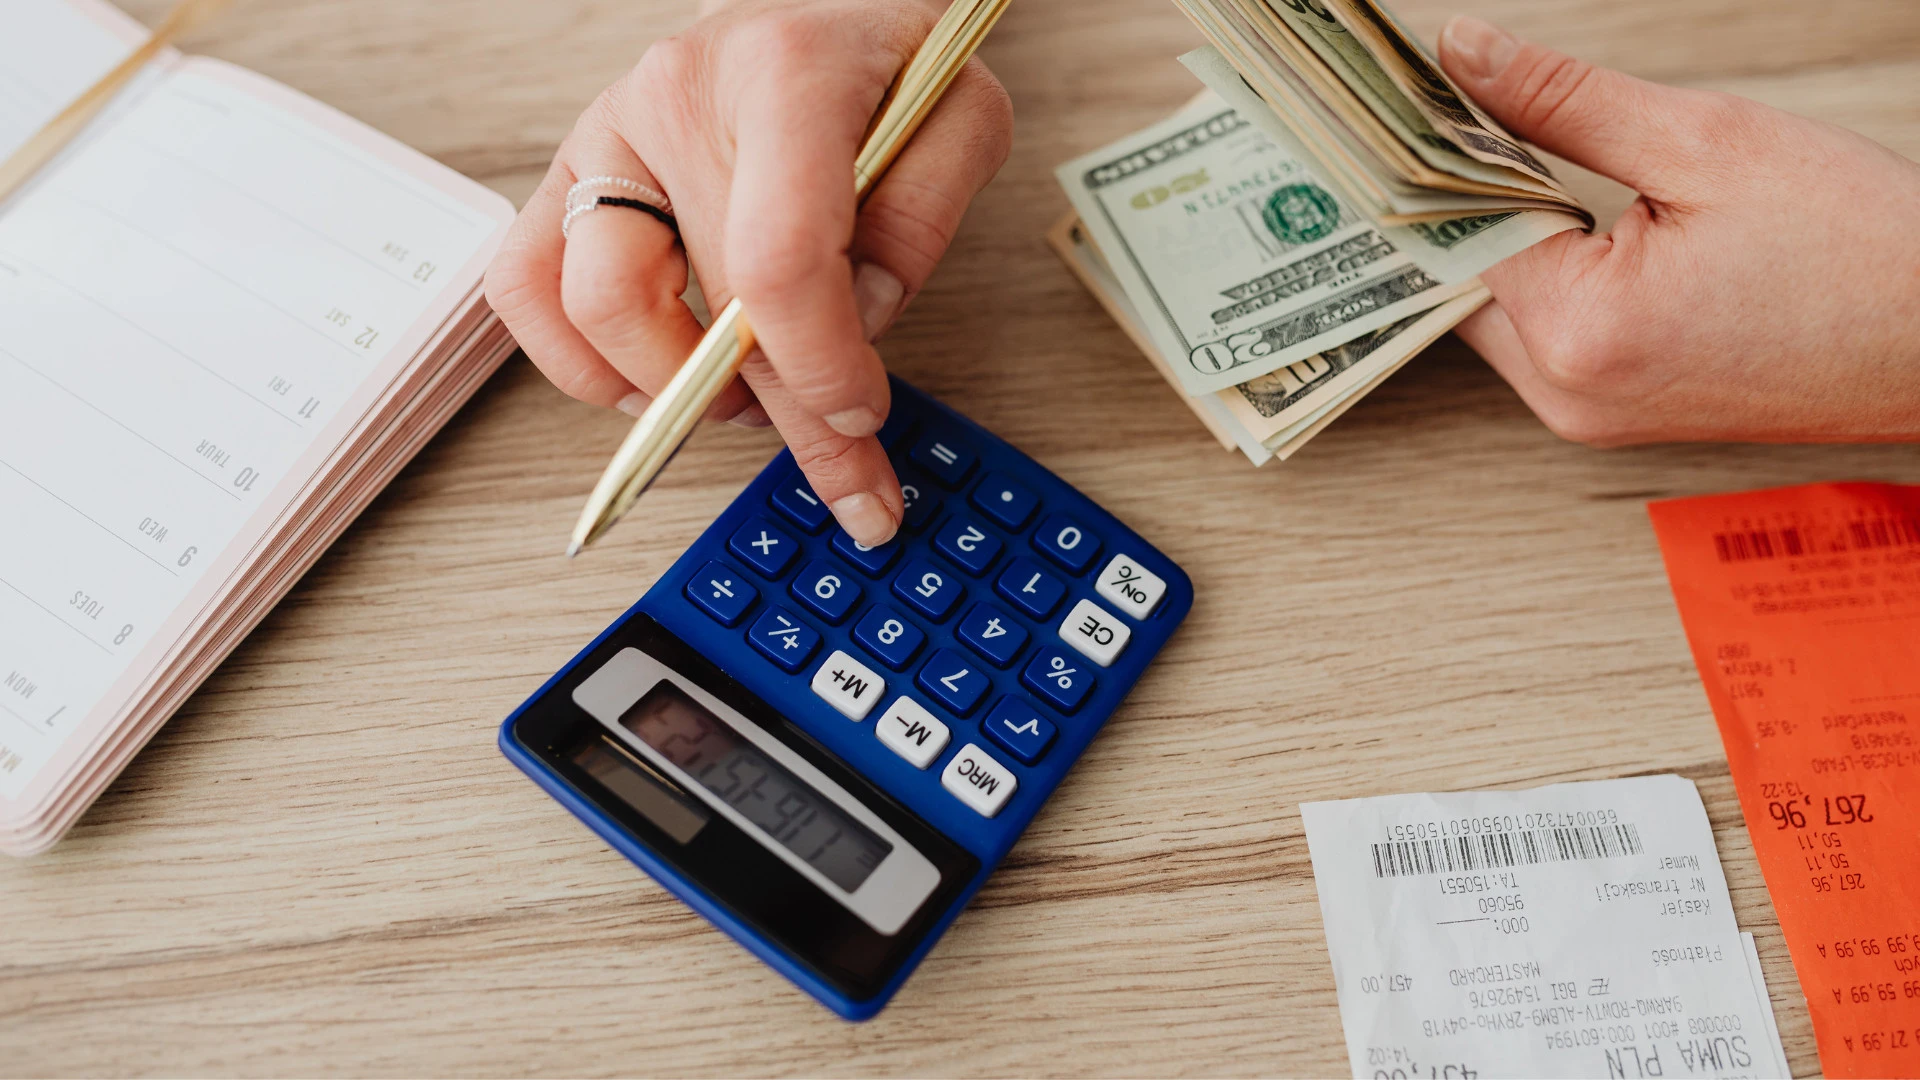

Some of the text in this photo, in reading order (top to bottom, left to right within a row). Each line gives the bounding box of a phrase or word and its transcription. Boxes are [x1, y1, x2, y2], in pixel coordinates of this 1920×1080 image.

[413, 261, 437, 283] 13
[1211, 265, 1336, 325] STATES
[1315, 297, 1376, 326] NOTE
[324, 307, 380, 349] 12 SAT
[1190, 327, 1273, 375] 20
[267, 375, 321, 419] 11 FRI
[195, 439, 260, 492] 10 THUR
[138, 517, 198, 567] 9 WED
[956, 525, 986, 552] 2
[1056, 526, 1083, 551] 0
[814, 574, 842, 600] 9
[914, 572, 943, 599] 5
[1021, 572, 1043, 595] 1
[1110, 565, 1147, 605] ON/C
[69, 590, 134, 646] 8 TUES
[876, 617, 905, 645] 8
[980, 616, 1008, 640] 4
[1078, 614, 1115, 647] CE
[830, 667, 870, 700] M+
[939, 667, 969, 693] 7
[1046, 656, 1077, 690] %
[3, 670, 67, 728] 7 MON
[957, 757, 1000, 797] MRC
[1760, 780, 1804, 800] 13:22
[1386, 809, 1618, 842] 6600473201095060150551
[1768, 793, 1875, 832] 267,96
[1796, 831, 1843, 851] 50,11
[1804, 852, 1851, 873] 50,11
[1439, 872, 1520, 895] TA:150551
[1595, 876, 1707, 902] Nr transakcji
[1810, 873, 1867, 894] 267,96
[1477, 893, 1525, 914] 95060
[1660, 898, 1712, 918] Kasjer
[1651, 945, 1724, 967] Płatność
[1815, 942, 1827, 959] A
[1834, 937, 1881, 959] 99,99
[1360, 960, 1542, 995] MASTERCARD 457,00
[1468, 981, 1578, 1010] BGI 15492676
[1831, 987, 1842, 1006] A
[1849, 981, 1897, 1005] 59,99
[1366, 1013, 1743, 1066] 000008 #001 000:601994 14:02
[1842, 1035, 1854, 1054] A
[1604, 1044, 1664, 1080] PLN
[1675, 1034, 1752, 1073] SUMA
